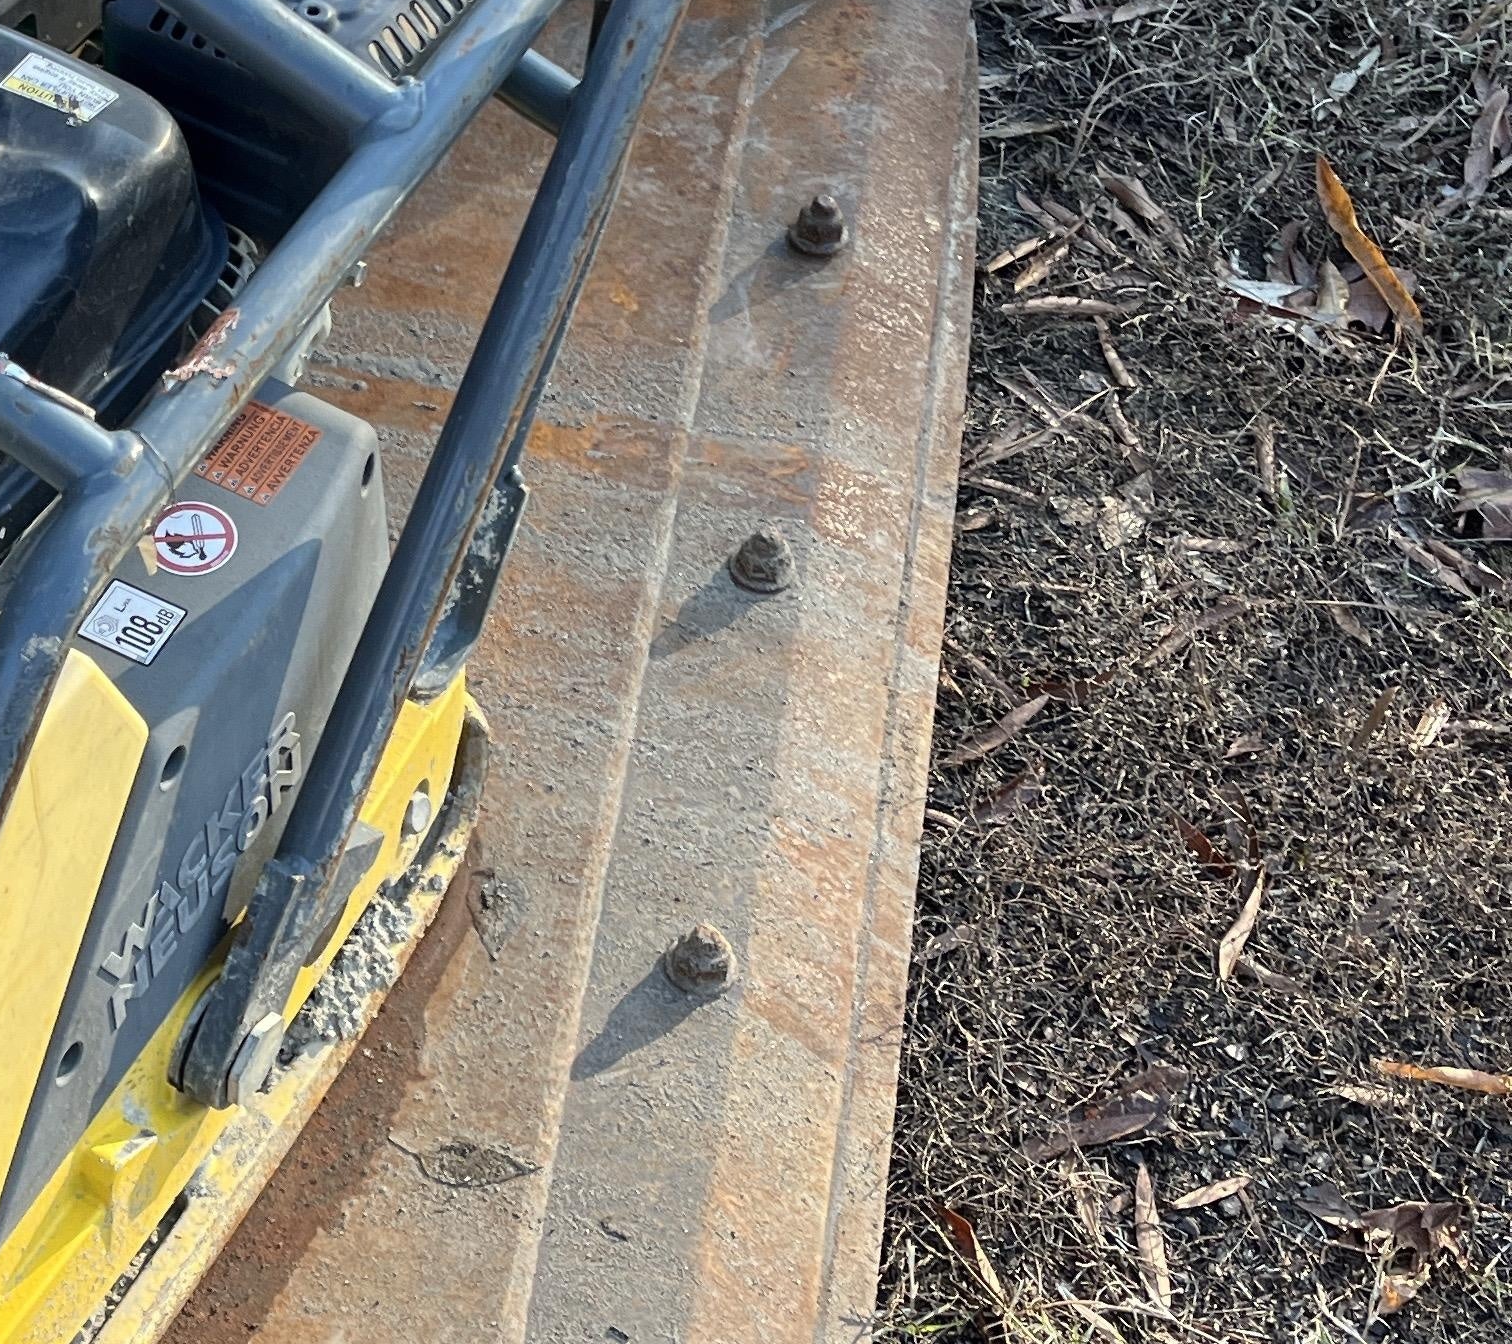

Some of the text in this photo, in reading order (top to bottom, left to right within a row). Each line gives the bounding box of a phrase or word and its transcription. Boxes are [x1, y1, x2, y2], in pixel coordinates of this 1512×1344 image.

[16, 83, 69, 107] UTION
[218, 414, 266, 470] WARNUNG
[235, 415, 288, 477] ADVERTENCIA
[250, 420, 303, 485] ADVERTISSEMENT
[266, 429, 320, 493] AVVERTENZA
[115, 608, 175, 654] 108 dB
[97, 711, 296, 986] WACKER
[106, 731, 302, 1025] NEUSON
